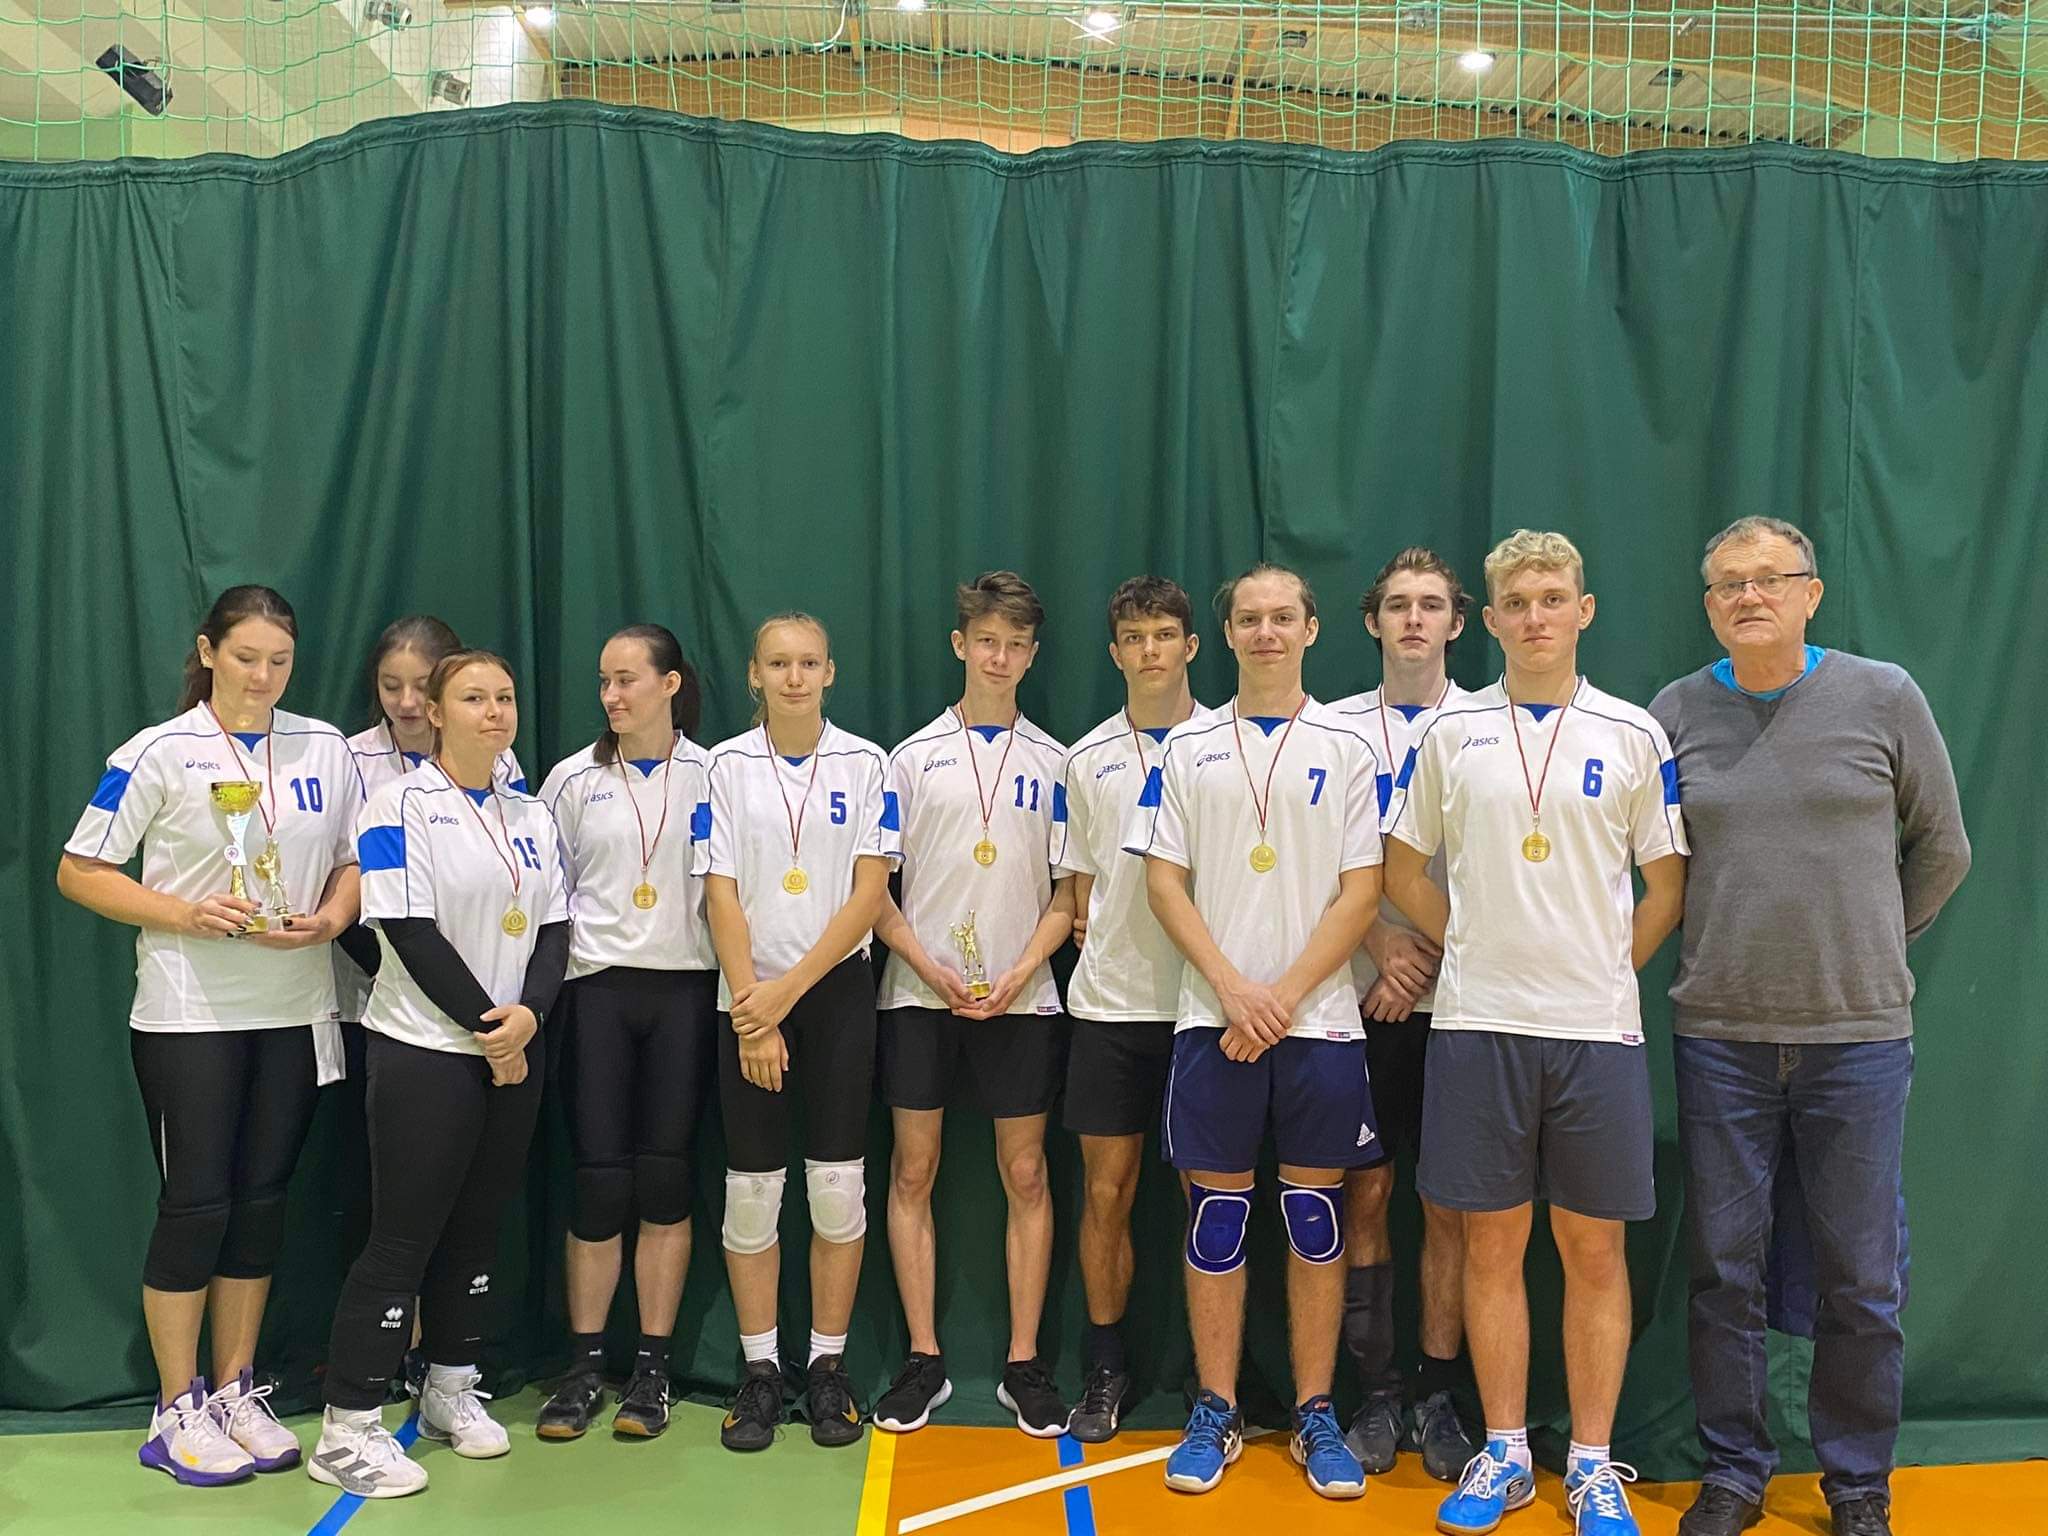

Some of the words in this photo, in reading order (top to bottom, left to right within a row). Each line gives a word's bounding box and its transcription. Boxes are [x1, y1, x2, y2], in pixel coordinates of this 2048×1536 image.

[290, 777, 323, 813] 10
[1014, 774, 1039, 811] 11
[1308, 767, 1327, 805] 7
[1583, 758, 1603, 798] 6
[830, 791, 847, 825] 5
[513, 837, 541, 871] 15
